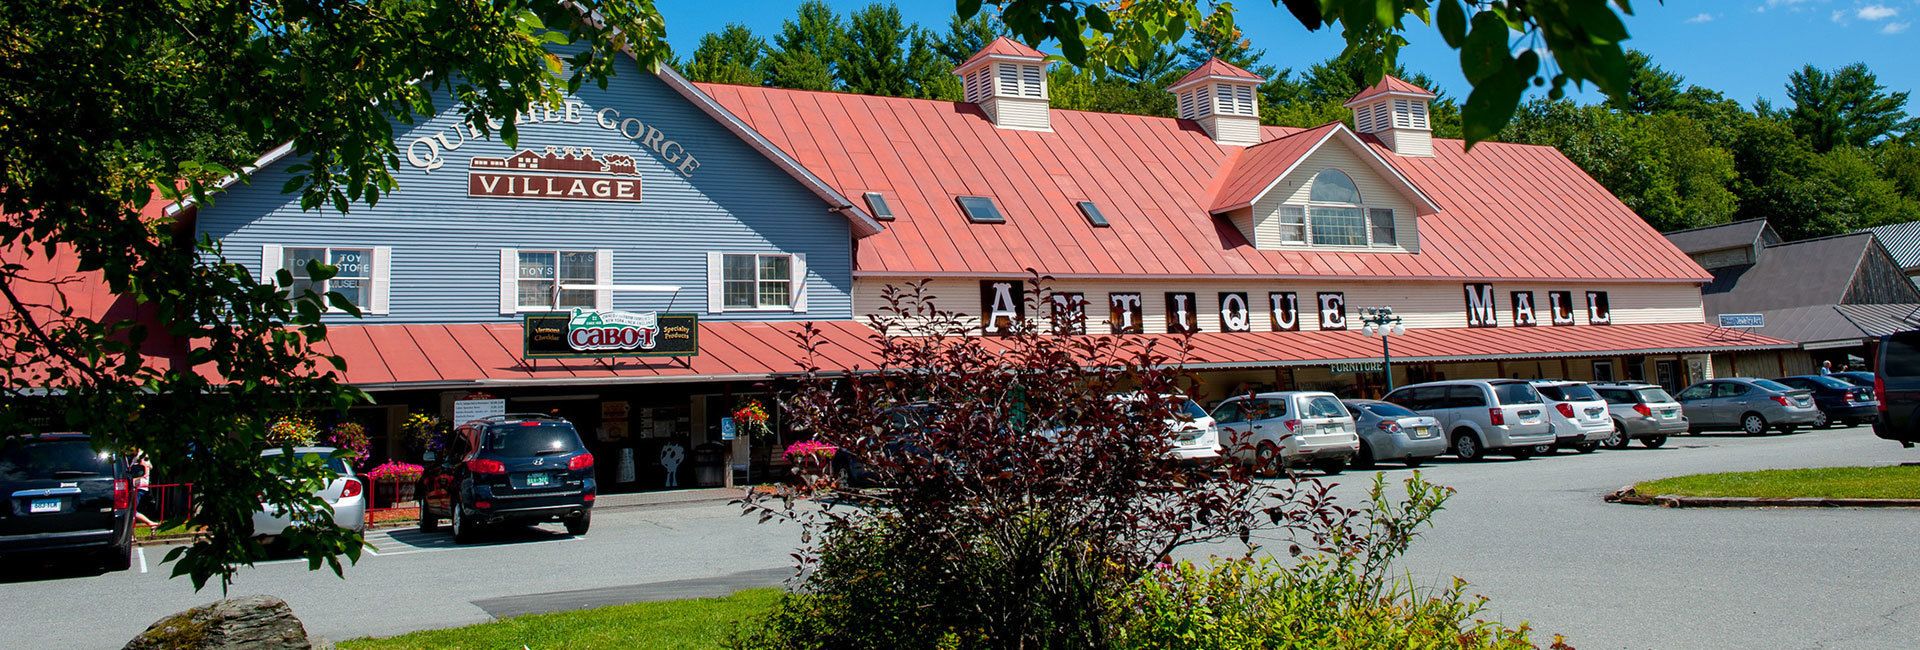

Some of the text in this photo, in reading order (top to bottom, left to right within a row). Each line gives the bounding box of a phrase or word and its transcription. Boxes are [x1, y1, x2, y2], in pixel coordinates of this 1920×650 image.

[597, 107, 701, 178] GORGE
[478, 175, 635, 198] VILLAGE
[341, 254, 362, 262] TOY
[335, 263, 370, 273] STORE
[521, 267, 554, 276] TOYS
[985, 282, 1610, 333] ANTIQUE MALL
[664, 326, 689, 334] Specialty
[1331, 362, 1383, 372] FURNITURE
